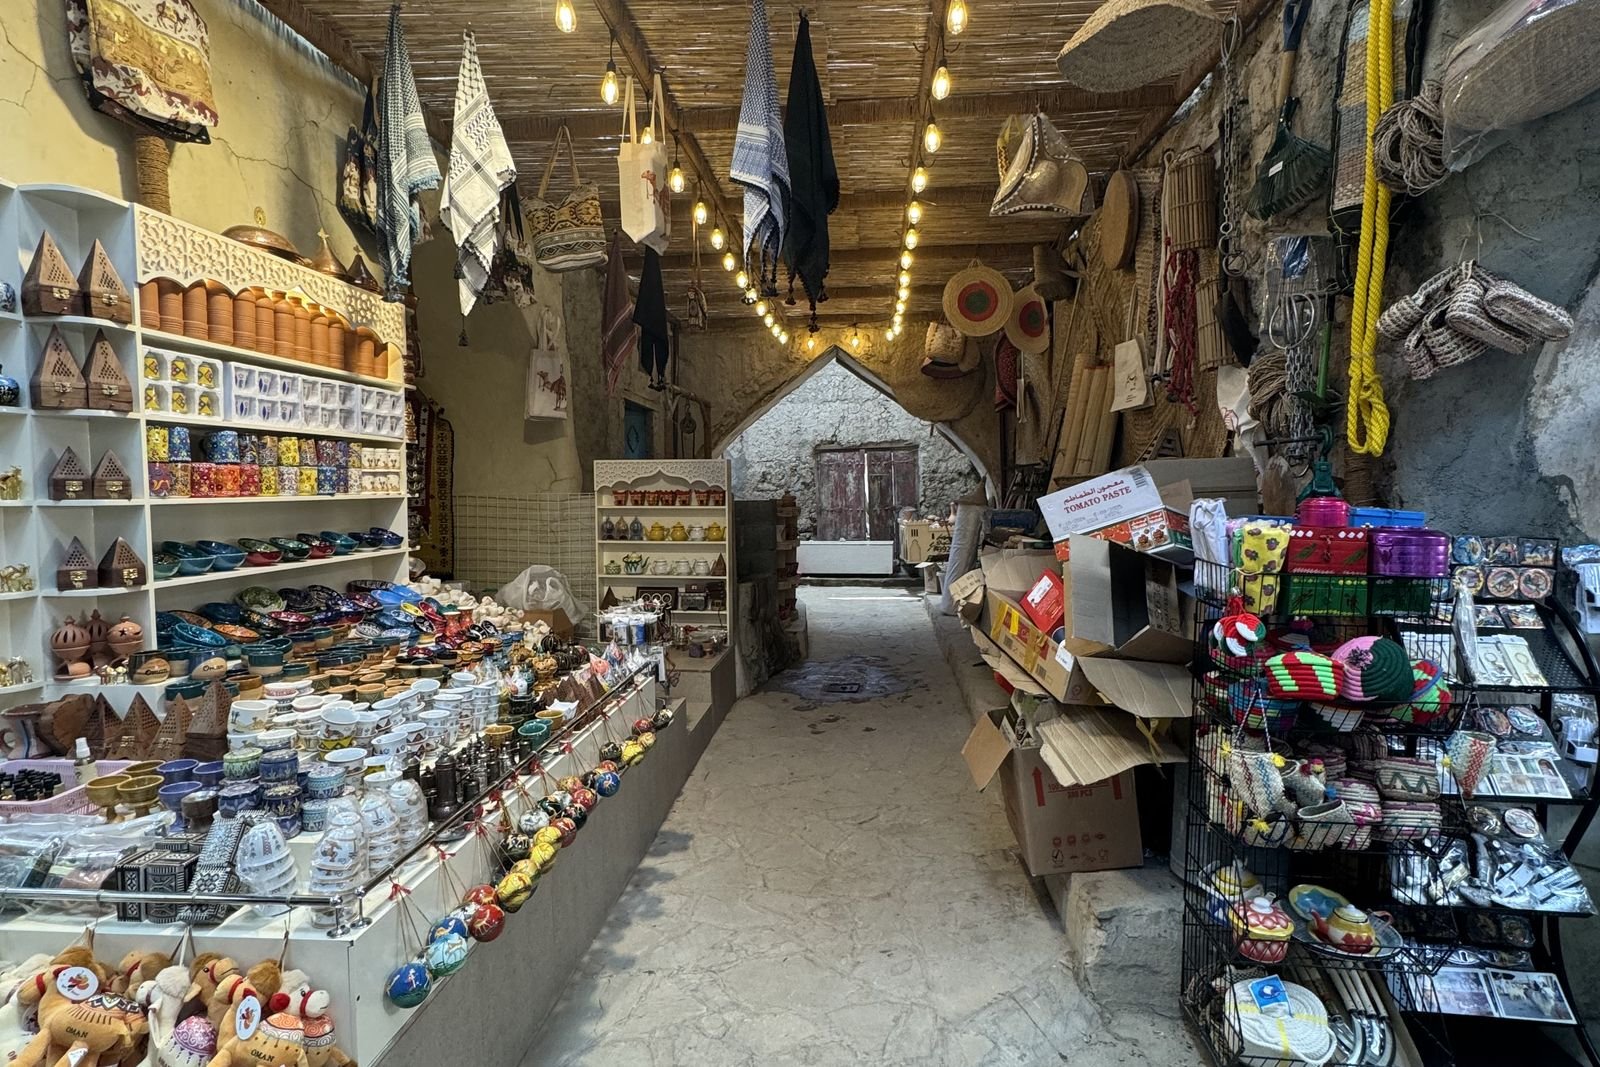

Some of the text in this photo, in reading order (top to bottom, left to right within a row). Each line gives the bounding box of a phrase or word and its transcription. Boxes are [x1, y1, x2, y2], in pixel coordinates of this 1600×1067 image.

[1063, 479, 1125, 505] معجون الطماطم
[1064, 496, 1101, 514] TOMATO
[1102, 486, 1132, 502] PASTE
[65, 1025, 89, 1039] OMAN
[250, 1049, 275, 1063] OMAN
